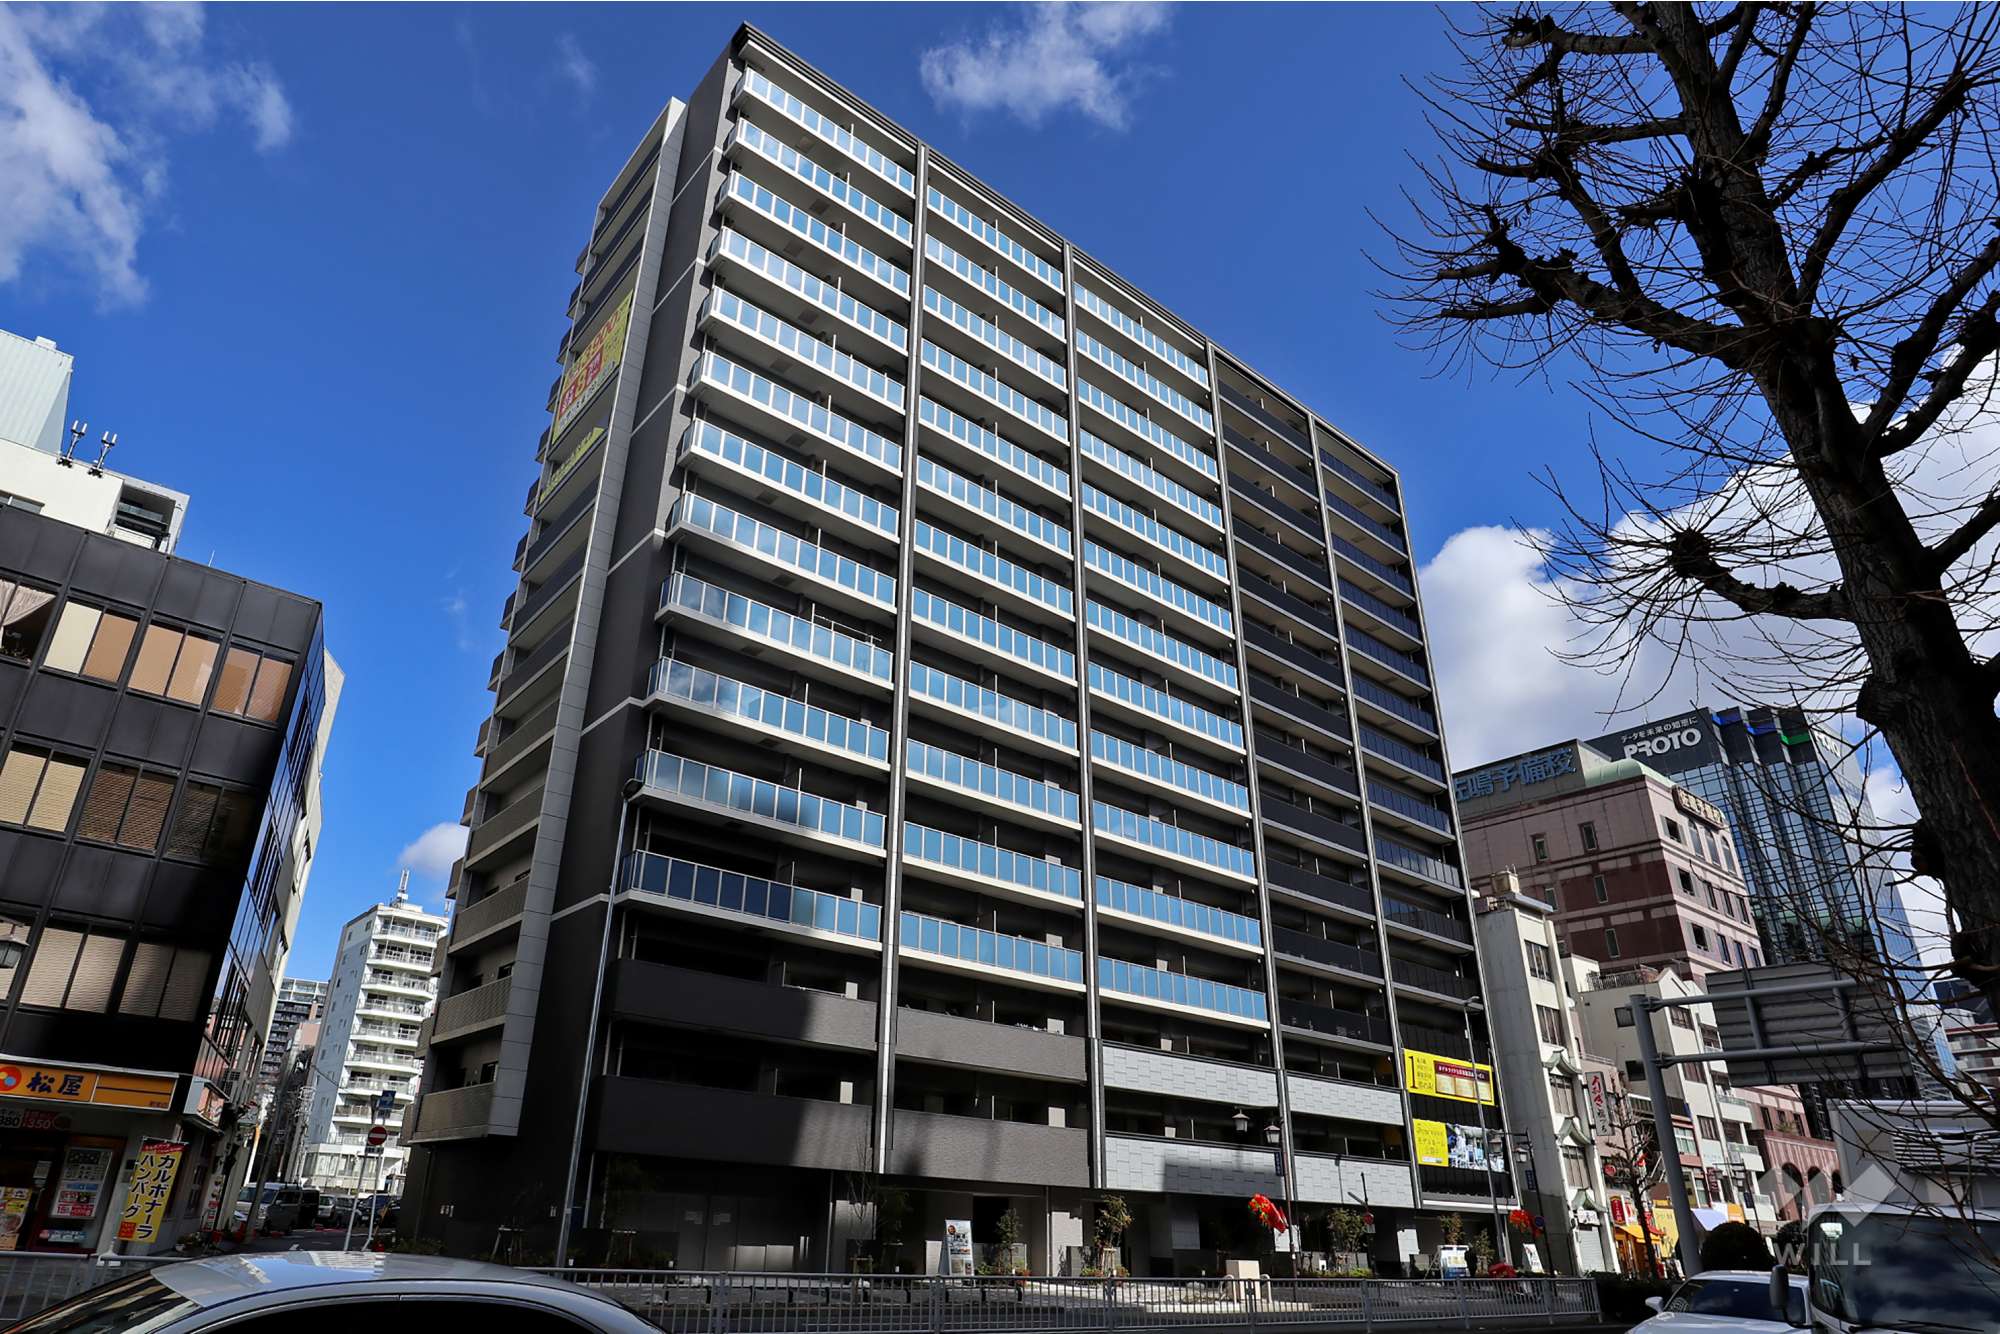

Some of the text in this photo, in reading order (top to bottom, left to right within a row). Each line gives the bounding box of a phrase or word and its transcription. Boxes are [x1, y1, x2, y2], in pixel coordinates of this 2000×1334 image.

[1624, 727, 1702, 759] PROTO
[26, 1071, 84, 1096] 松屋
[125, 1154, 155, 1219] ハンバーグ
[137, 1154, 176, 1240] カルボナーラ
